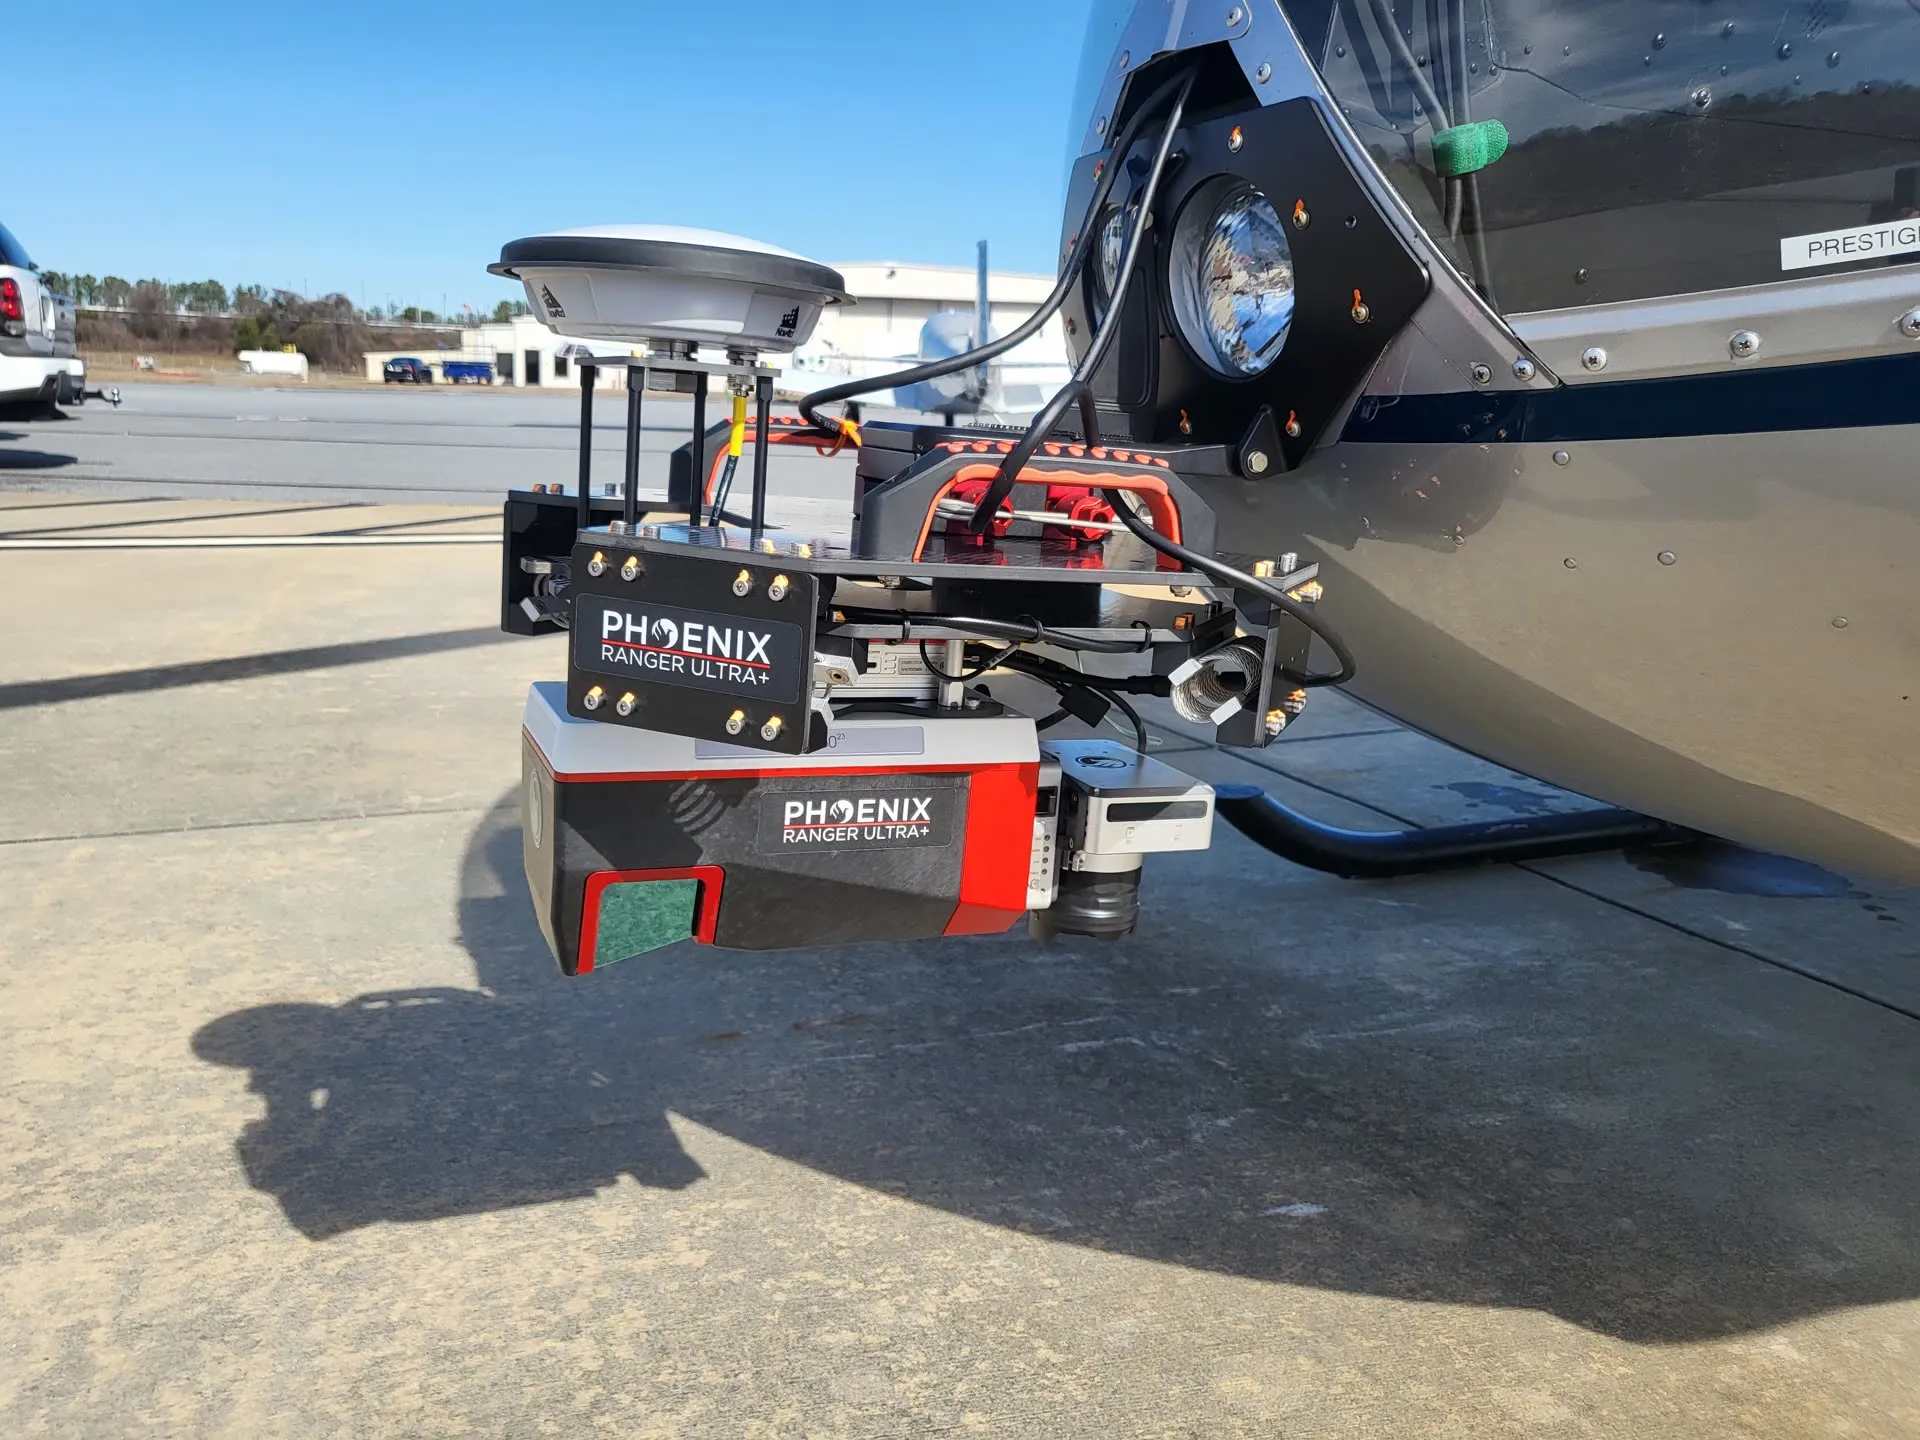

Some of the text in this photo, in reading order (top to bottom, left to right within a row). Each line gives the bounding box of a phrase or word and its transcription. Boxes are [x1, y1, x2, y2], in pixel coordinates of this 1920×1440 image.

[1808, 226, 1920, 259] PRESTIG
[602, 609, 772, 665] PHOENIX
[601, 644, 770, 686] RANGER ULTRA+
[783, 797, 933, 826] PHOENIX
[782, 825, 930, 844] RANGER ULTRA+
